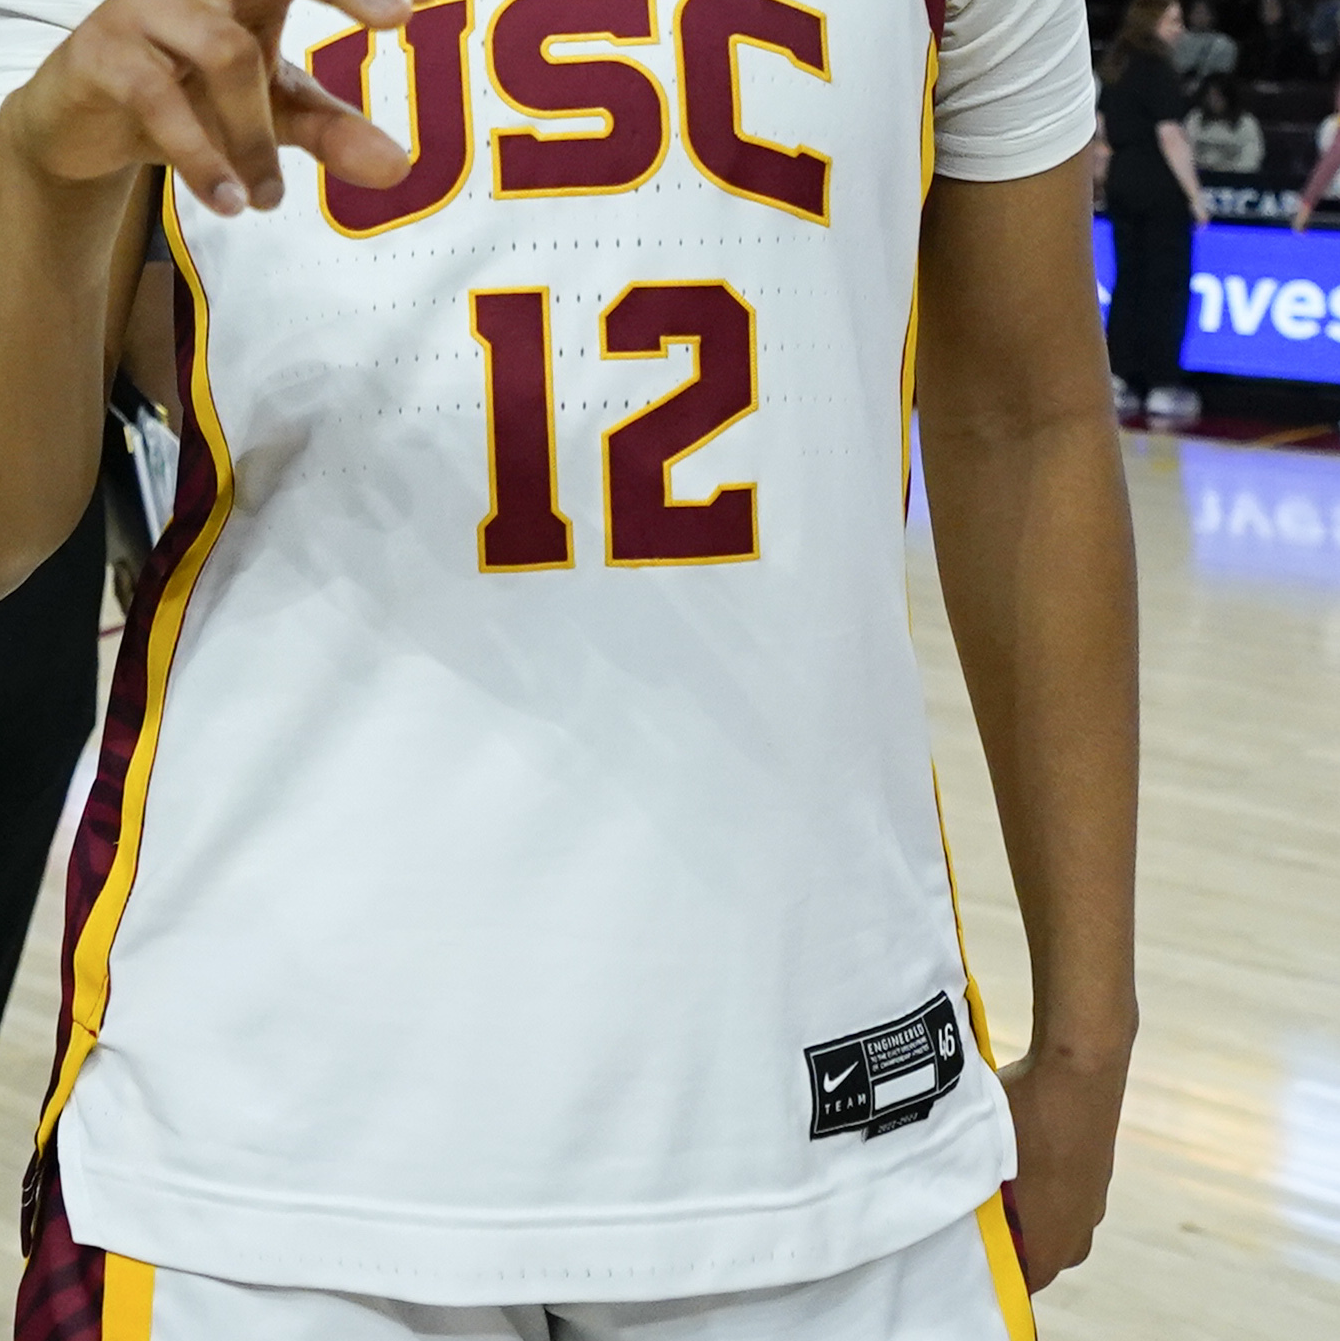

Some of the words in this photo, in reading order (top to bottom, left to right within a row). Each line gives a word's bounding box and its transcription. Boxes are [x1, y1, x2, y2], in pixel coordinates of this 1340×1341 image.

[469, 279, 760, 573] 12
[866, 1023, 925, 1055] ENGINEERED
[938, 1022, 956, 1060] 46
[824, 1092, 867, 1115] TEAM
